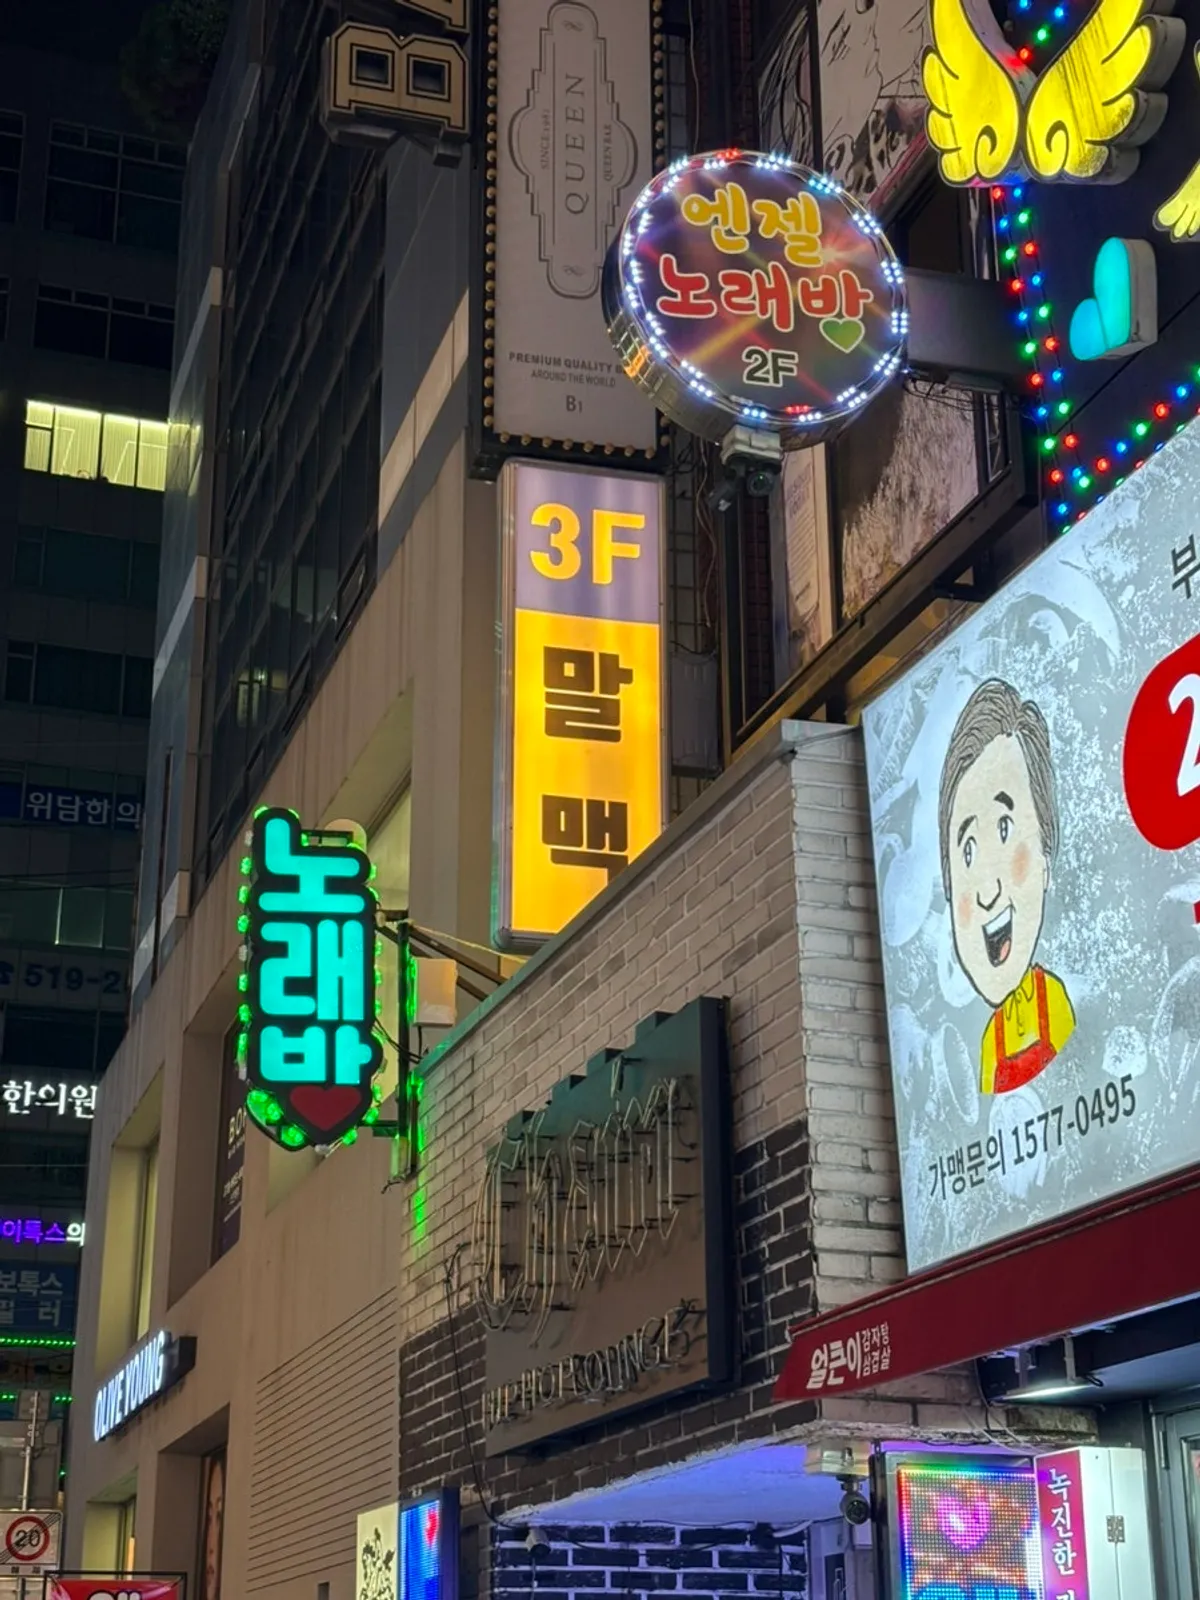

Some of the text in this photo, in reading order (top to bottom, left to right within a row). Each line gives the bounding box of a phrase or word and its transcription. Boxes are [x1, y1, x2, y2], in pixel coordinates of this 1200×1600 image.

[565, 73, 590, 214] QUEEN
[682, 182, 823, 267] 엔젤
[509, 352, 562, 368] PREMIUM
[564, 358, 613, 374] QUALITY
[531, 370, 616, 388] AROUND THE WORLD
[742, 346, 798, 388] 2F
[566, 395, 583, 413] B1
[529, 502, 646, 586] 3F
[2, 1080, 99, 1119] 한의원
[929, 1074, 1136, 1200] 가맹문의 1577-0495
[0, 1270, 63, 1297] 보톡스
[806, 1321, 890, 1390] 얼큰이 감자탕
[862, 1345, 892, 1377] 삼겹살
[94, 1330, 165, 1442] OLIVE YOUNG
[15, 1530, 41, 1548] 20
[1047, 1468, 1076, 1576] 녹진한
